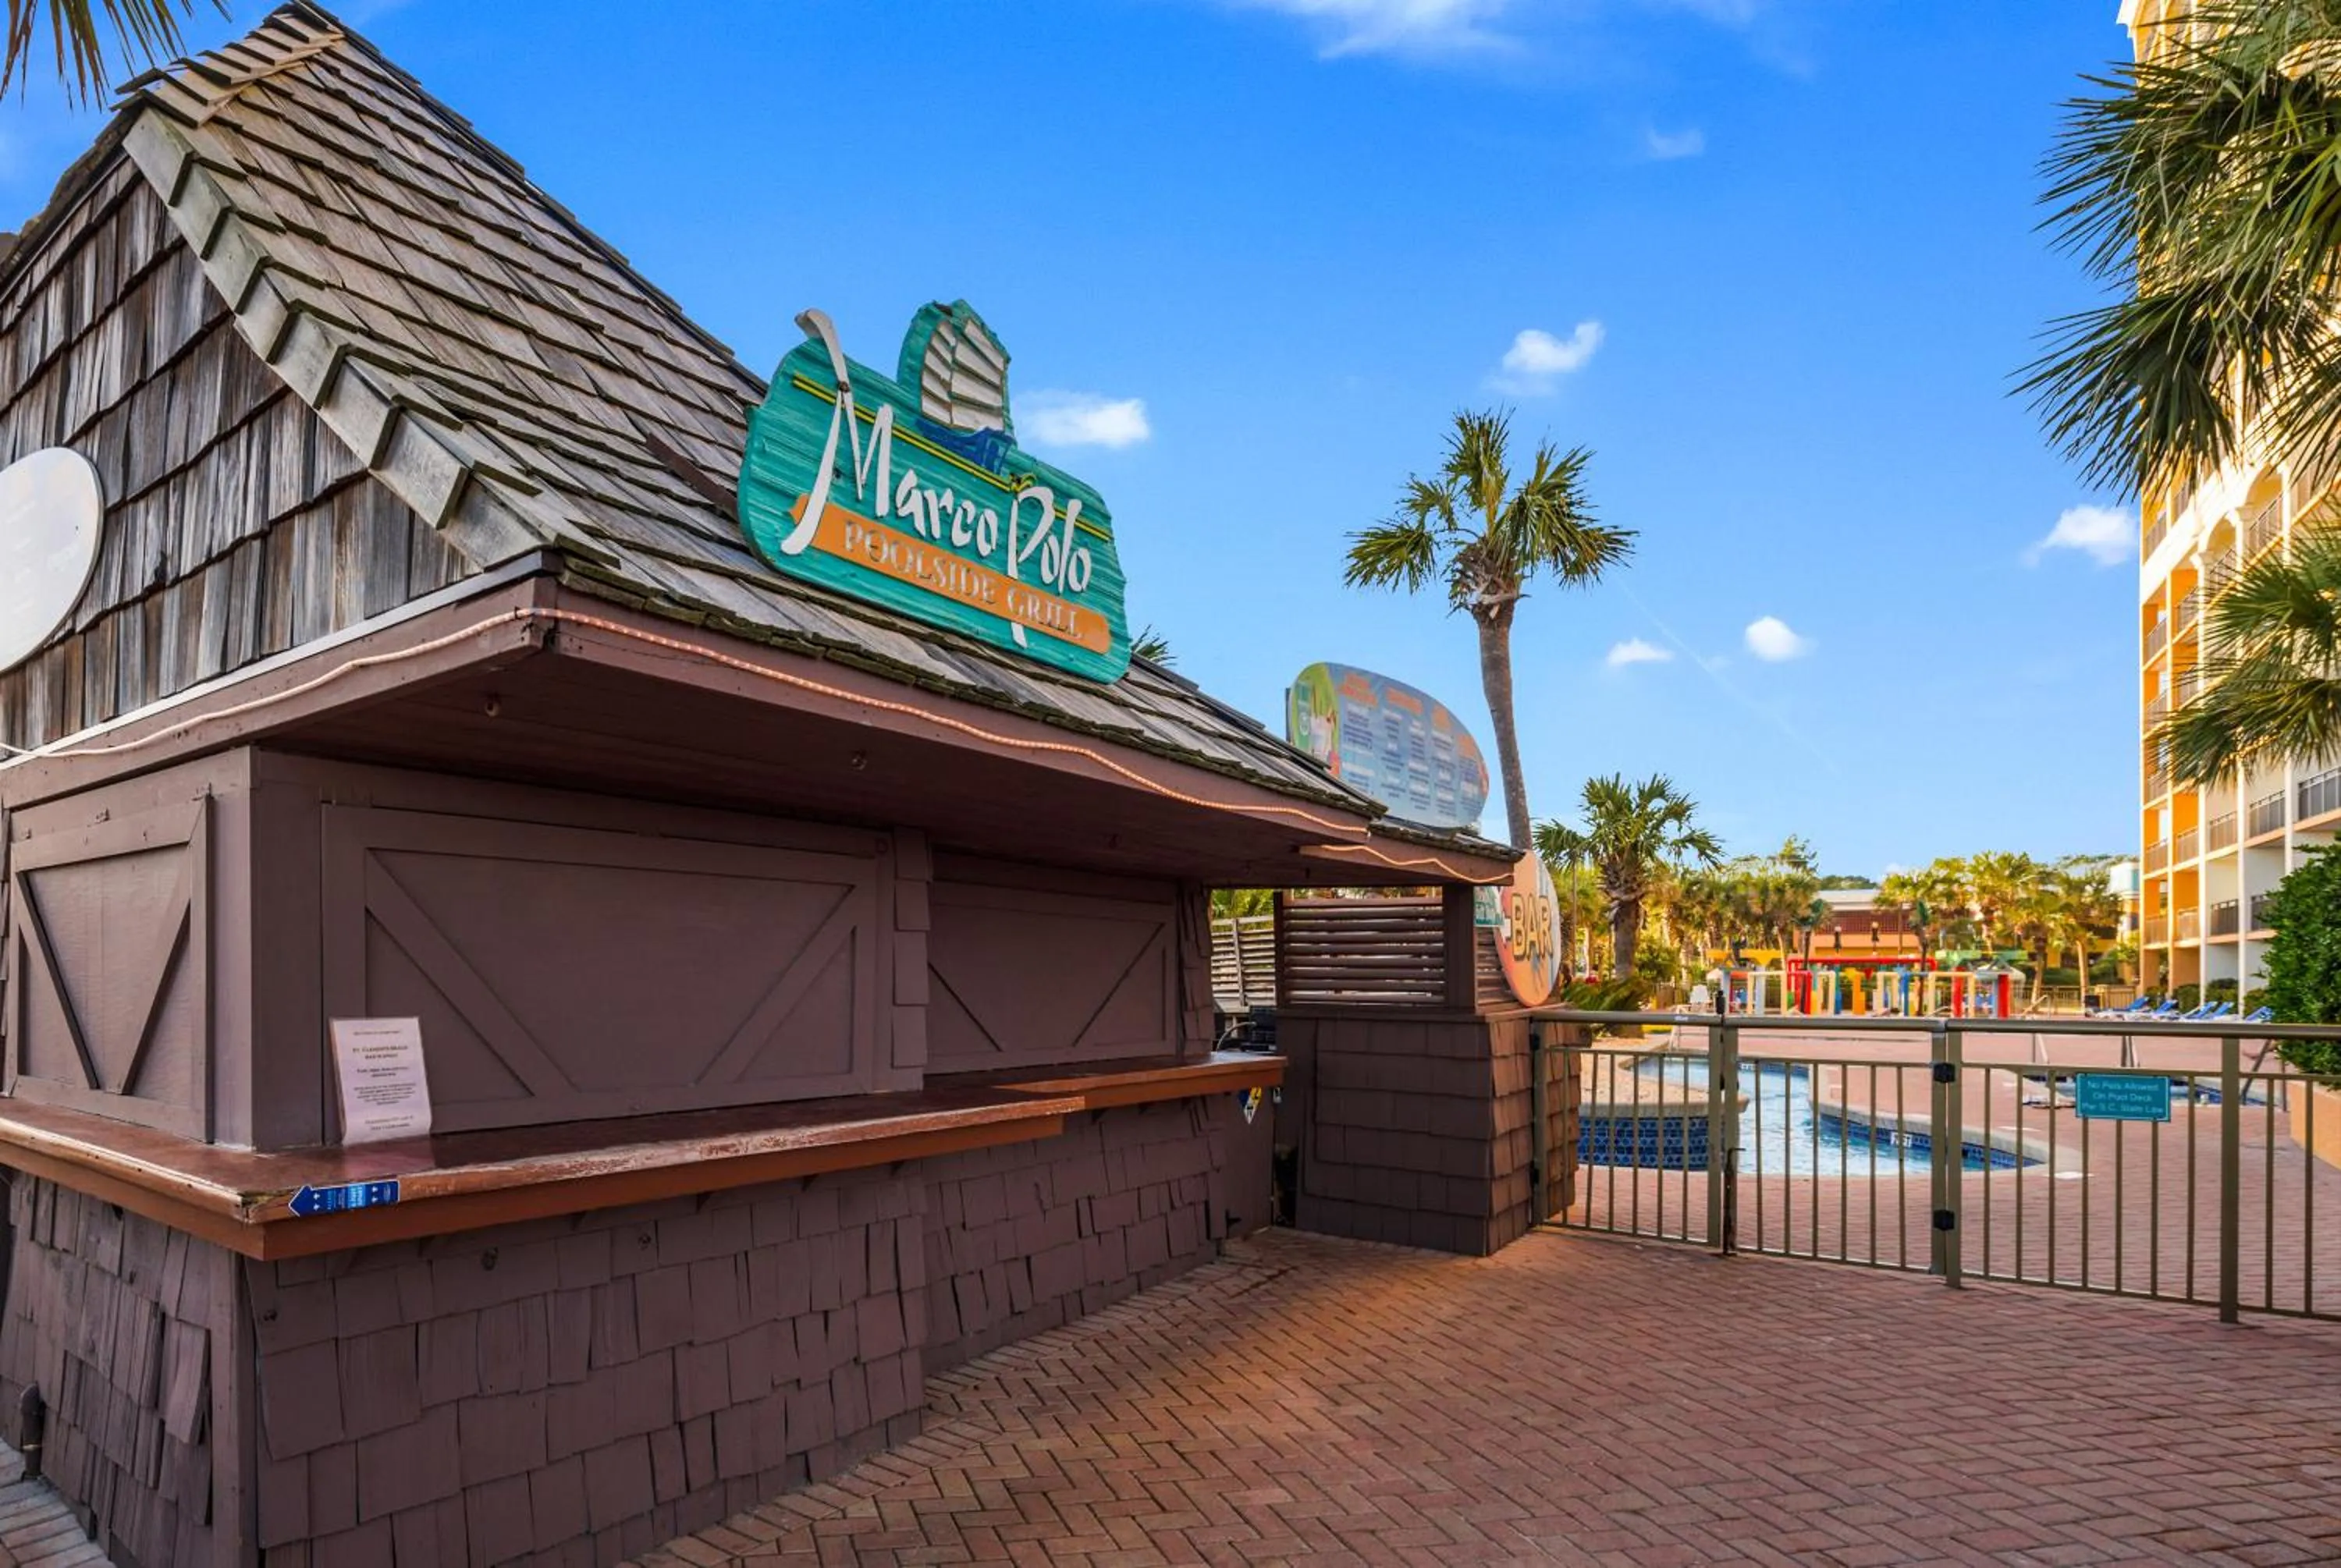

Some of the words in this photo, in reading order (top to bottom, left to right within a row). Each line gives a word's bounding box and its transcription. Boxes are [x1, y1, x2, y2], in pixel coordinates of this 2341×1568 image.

[781, 308, 998, 556] Marco
[1007, 486, 1092, 648] Polo
[844, 520, 996, 605] POOLSIDE
[1007, 587, 1083, 640] GRILL
[1511, 893, 1553, 960] BAR
[2108, 1092, 2128, 1102] Pool
[2130, 1093, 2152, 1102] Deck
